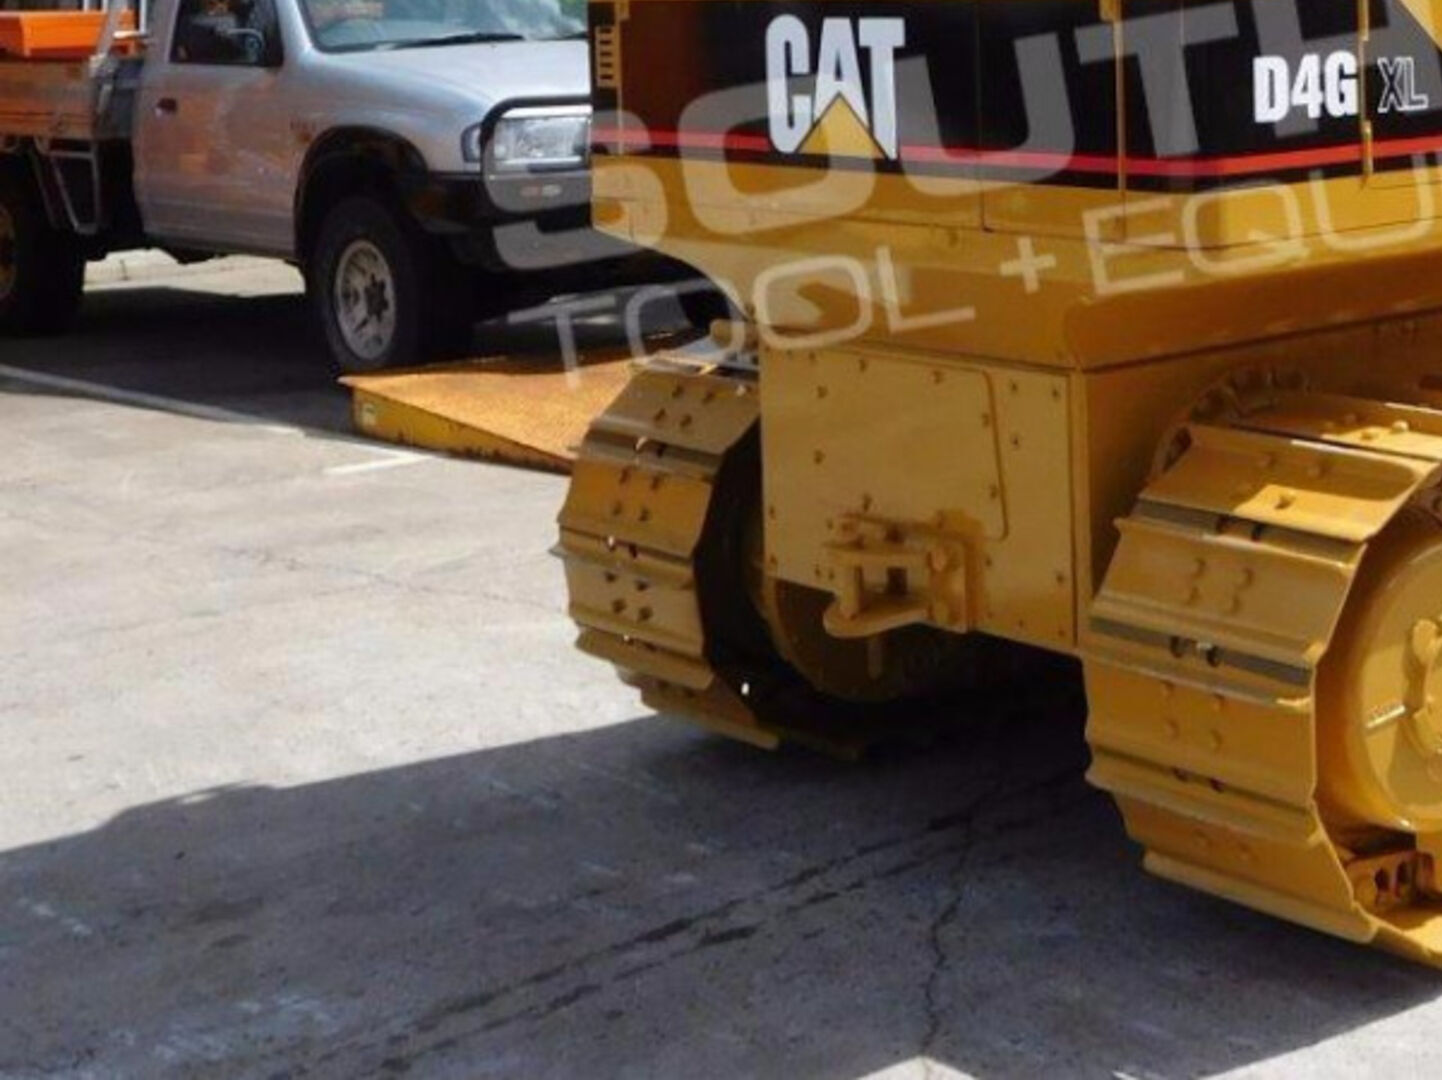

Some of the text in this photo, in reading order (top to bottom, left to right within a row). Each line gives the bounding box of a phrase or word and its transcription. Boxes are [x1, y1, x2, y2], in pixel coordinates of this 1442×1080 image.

[765, 14, 906, 160] CAT
[1254, 50, 1428, 123] D4G XL
